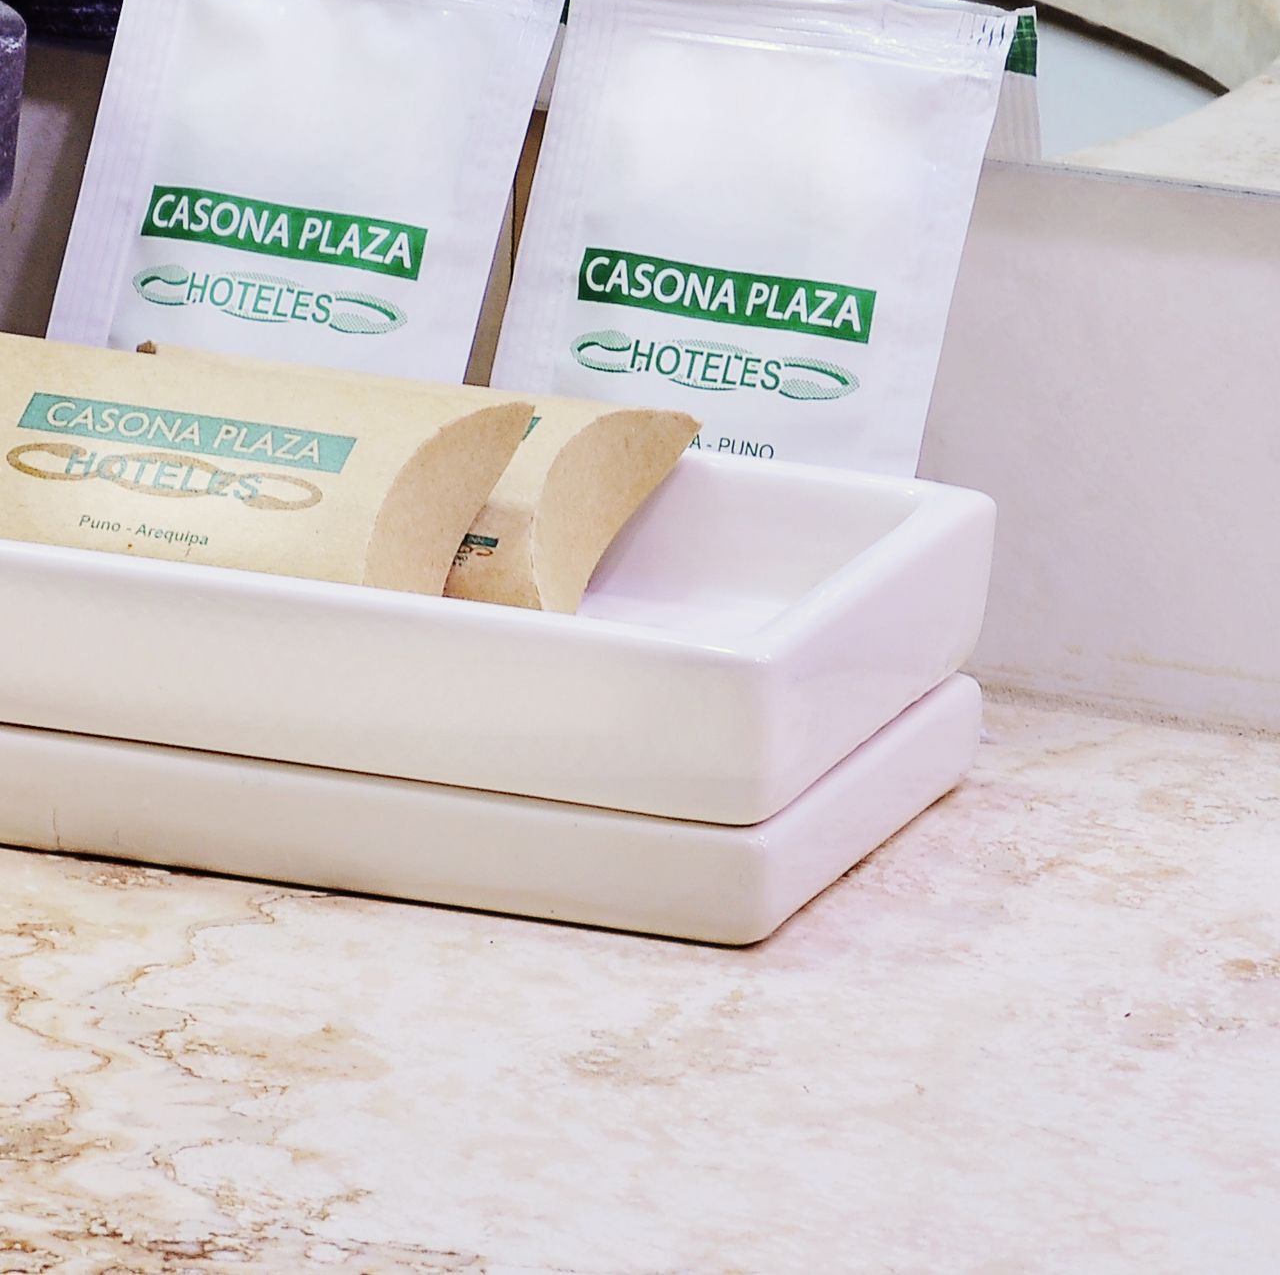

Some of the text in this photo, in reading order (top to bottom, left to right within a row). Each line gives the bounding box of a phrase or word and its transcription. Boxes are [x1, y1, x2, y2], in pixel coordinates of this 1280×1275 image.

[151, 193, 412, 269] CASONA PLAZA
[186, 272, 333, 323] HOTELES
[585, 256, 861, 332] CASONA PLAZA
[630, 339, 782, 391] HOTELES
[46, 401, 322, 465] CASONA PLAZA
[717, 436, 775, 460] PUNO
[64, 451, 263, 501] HOTELES
[78, 514, 122, 533] Puno
[134, 523, 210, 548] Arequipa
